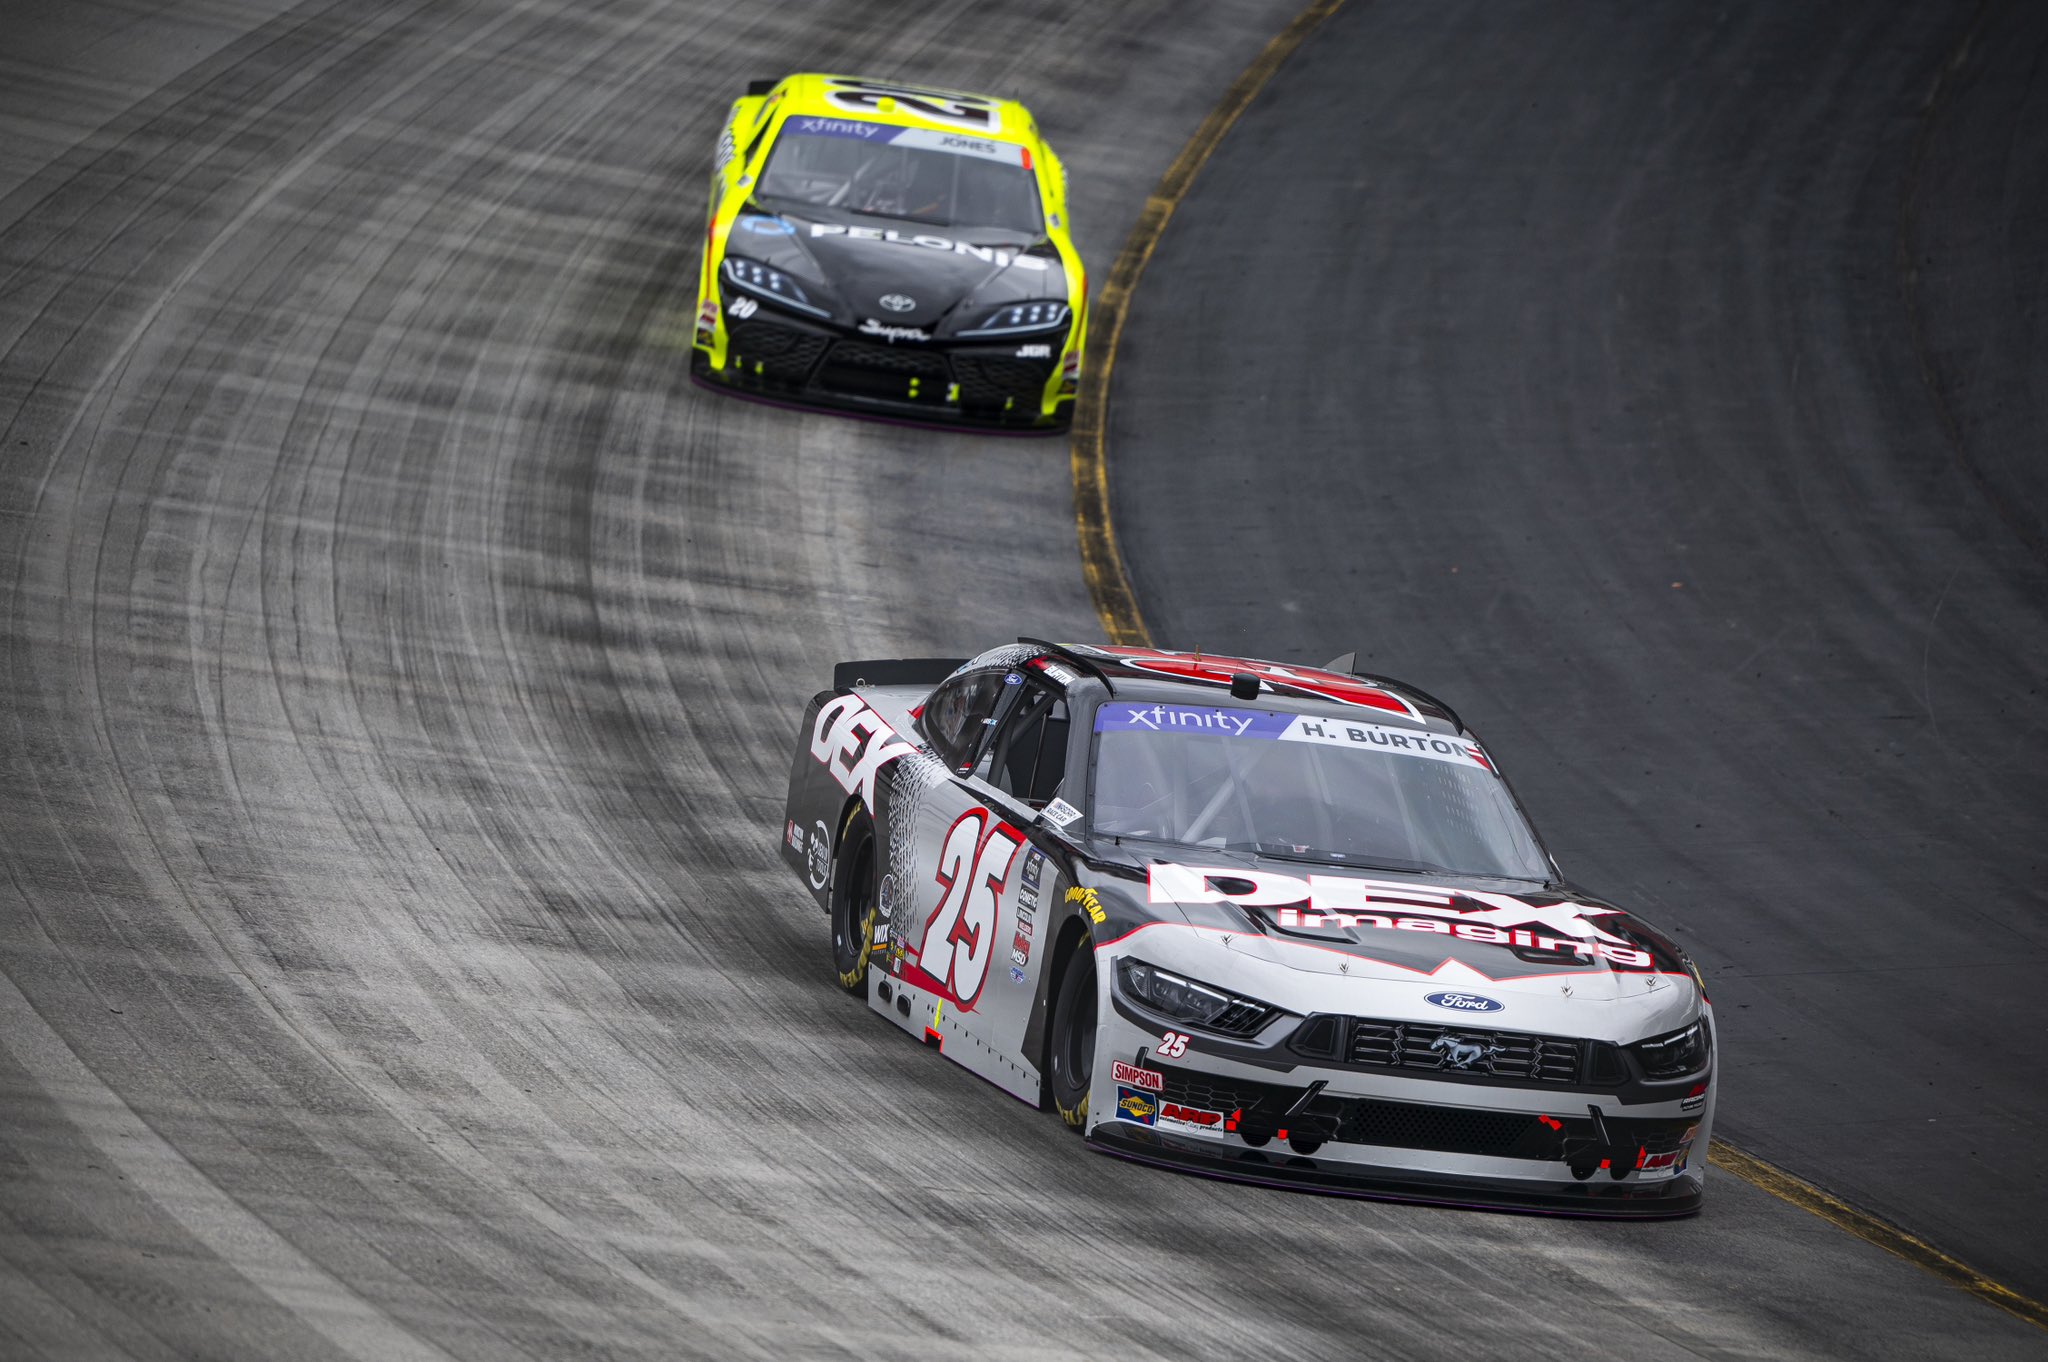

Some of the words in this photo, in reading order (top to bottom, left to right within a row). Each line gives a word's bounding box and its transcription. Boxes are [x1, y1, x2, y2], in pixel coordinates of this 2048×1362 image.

[801, 117, 880, 138] xfinity
[939, 134, 997, 155] JONES
[811, 223, 1049, 271] PELONIS
[728, 296, 758, 319] 20
[859, 319, 931, 343] Supra
[1128, 706, 1253, 736] xfinity
[1302, 722, 1336, 740] H.
[1347, 728, 1472, 759] BURTON
[917, 808, 1026, 1011] 25
[1148, 864, 1632, 945] DEX
[873, 924, 890, 944] WIX
[1278, 908, 1654, 968] imaging
[1011, 948, 1027, 966] MSD
[1440, 992, 1489, 1011] Ford
[1156, 1031, 1190, 1058] 25
[1115, 1064, 1160, 1088] SIMPSON
[1120, 1099, 1154, 1114] SUNOCO
[1161, 1103, 1222, 1125] ARP
